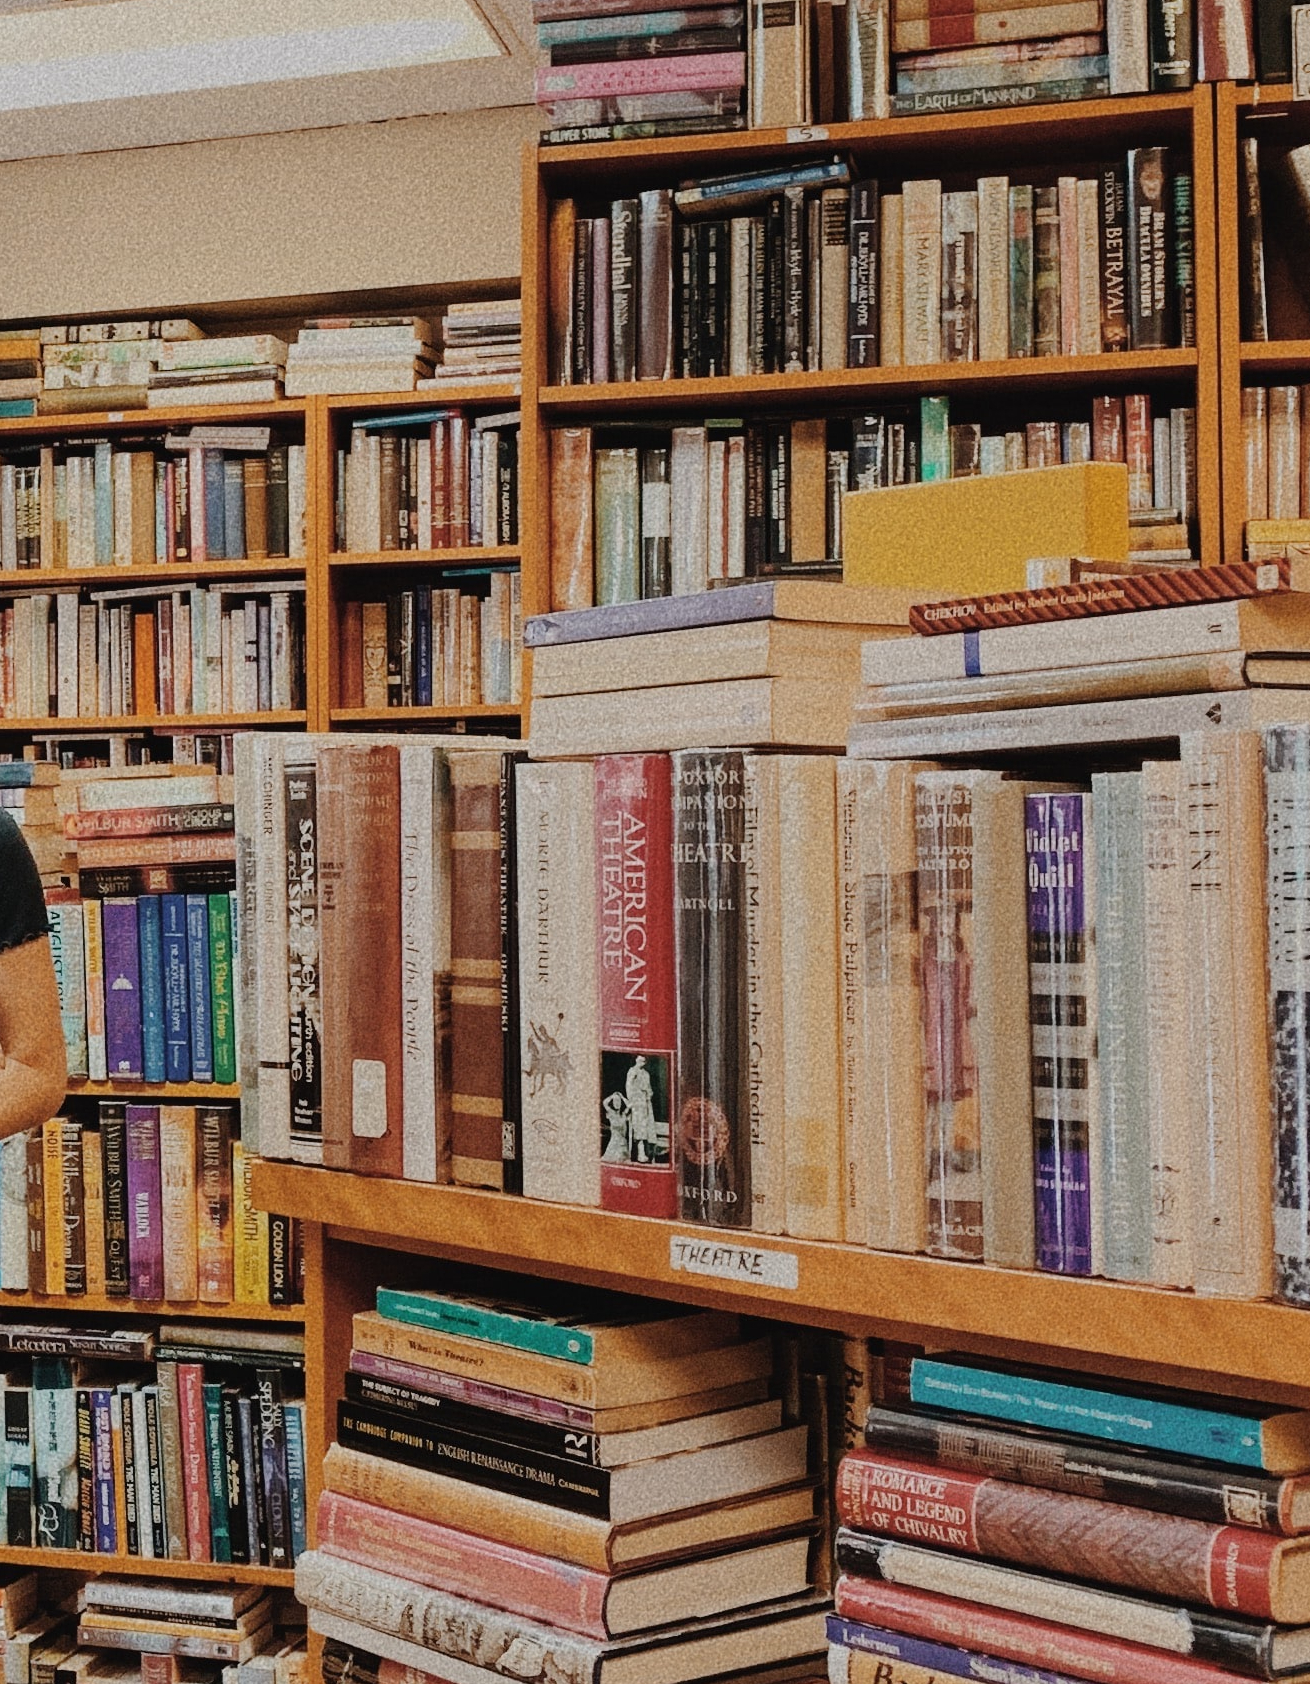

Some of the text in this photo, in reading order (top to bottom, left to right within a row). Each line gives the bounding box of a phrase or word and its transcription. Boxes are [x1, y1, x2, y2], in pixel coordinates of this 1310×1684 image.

[1105, 227, 1124, 320] BETRAYAL
[923, 603, 978, 621] CHEKHOV
[135, 814, 179, 829] SMITH
[1025, 827, 1080, 853] Violet
[601, 811, 623, 969] THEATRE
[622, 811, 648, 1002] AMERICAN
[843, 789, 859, 1025] Victorian Stage Pulpiteer
[746, 885, 761, 967] Murder
[299, 817, 315, 1082] SCENE edition
[403, 960, 421, 990] the
[748, 975, 761, 998] in
[403, 997, 423, 1060] People
[748, 1004, 762, 1036] the
[47, 1130, 58, 1159] NOISE
[203, 1115, 220, 1167] WILBUR
[272, 1220, 285, 1288] GOLDEN LION
[675, 1242, 765, 1277] THEATRE
[375, 1382, 401, 1397] SUBJECT
[258, 1380, 274, 1450] SPEDDING
[188, 1453, 200, 1485] Dawn
[437, 1443, 470, 1464] ENGLISH
[470, 1451, 524, 1478] RENAISSANCE
[525, 1466, 556, 1487] DRAMA
[870, 1468, 948, 1500] ROMANCE
[870, 1491, 967, 1526] AND LEGEND
[871, 1510, 969, 1546] OF CHIVALRY
